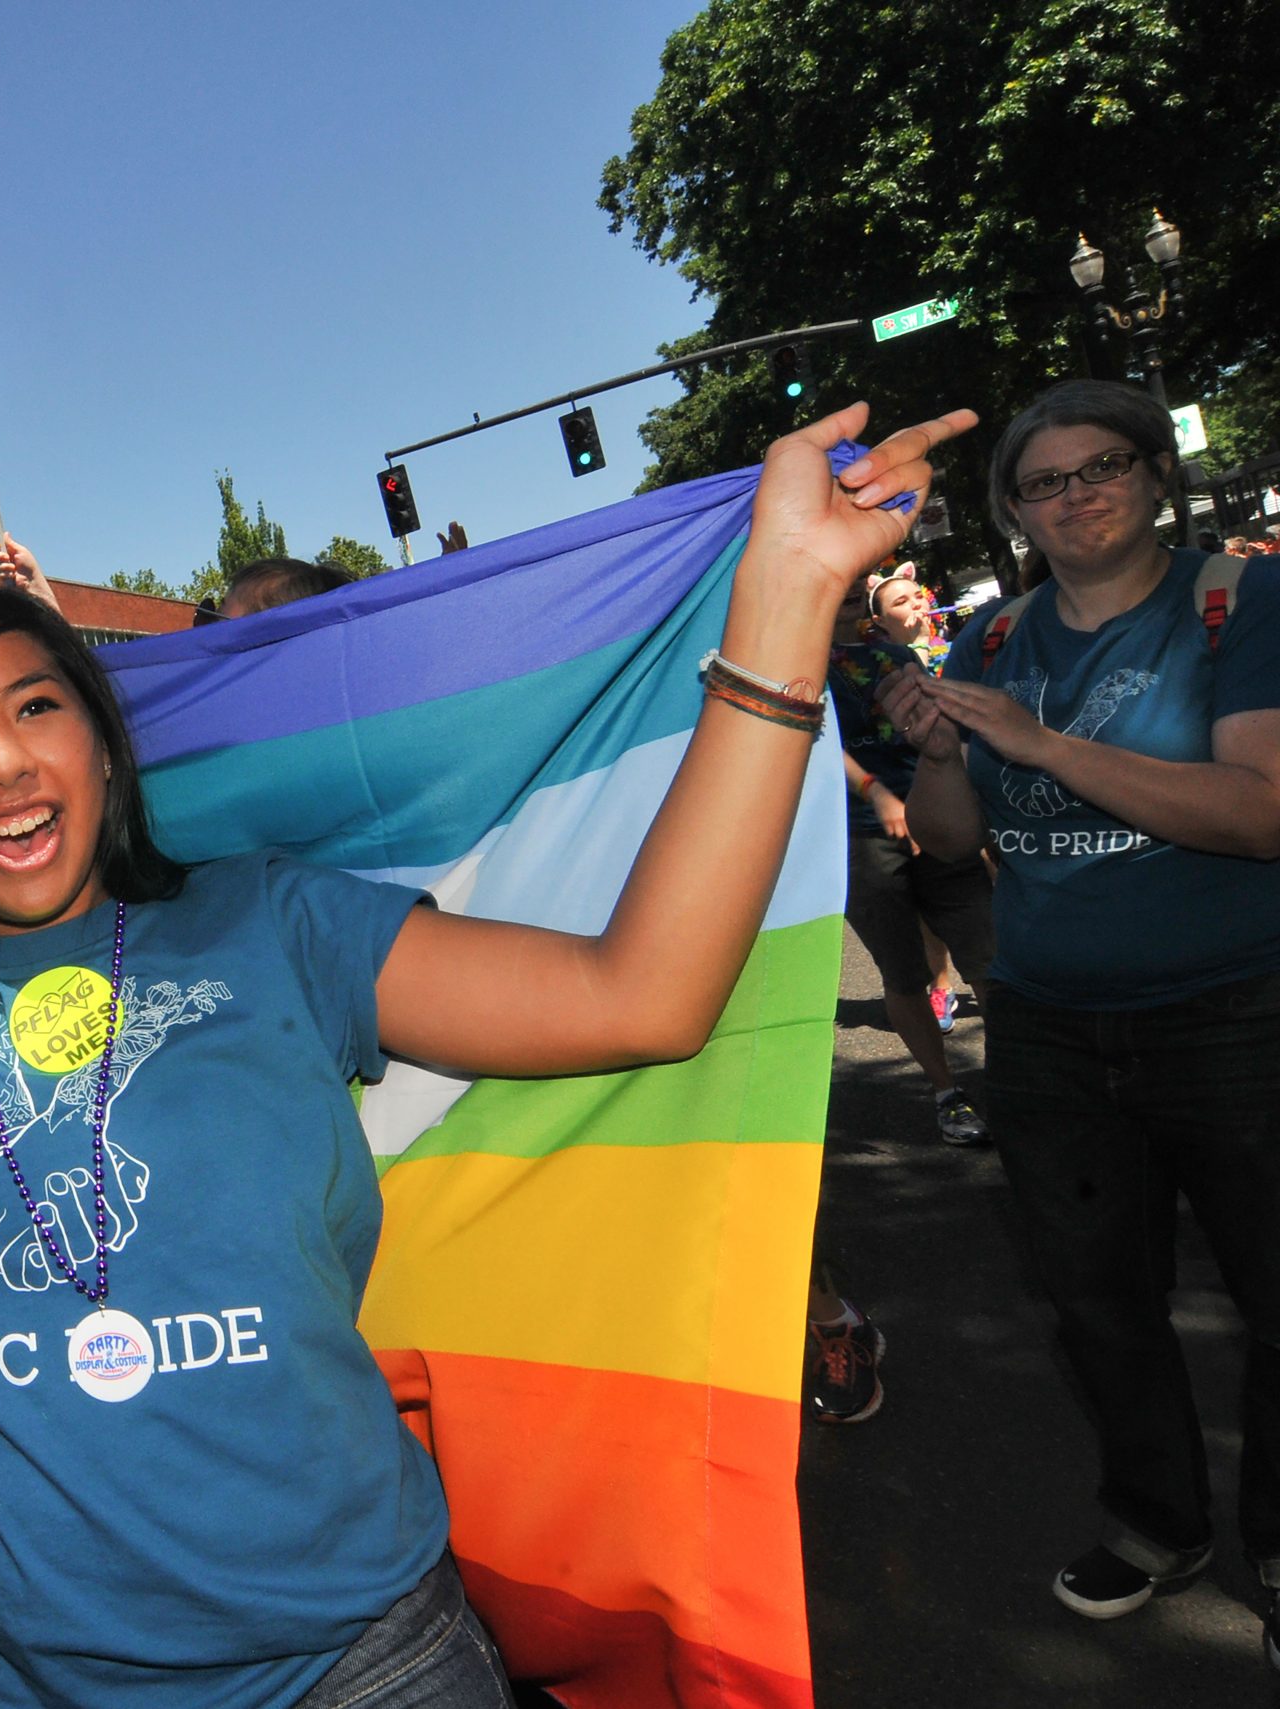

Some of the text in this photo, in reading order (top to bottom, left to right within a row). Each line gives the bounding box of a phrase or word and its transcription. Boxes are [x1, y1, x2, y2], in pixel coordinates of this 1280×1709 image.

[900, 312, 918, 330] SW
[1049, 830, 1151, 856] PRIDE
[14, 978, 94, 1042] PFLAG
[65, 1032, 107, 1066] ME
[65, 1306, 268, 1383] IDE
[87, 1335, 130, 1356] PARTY
[75, 1359, 104, 1371] DISPLAY
[115, 1354, 148, 1367] COSTUME
